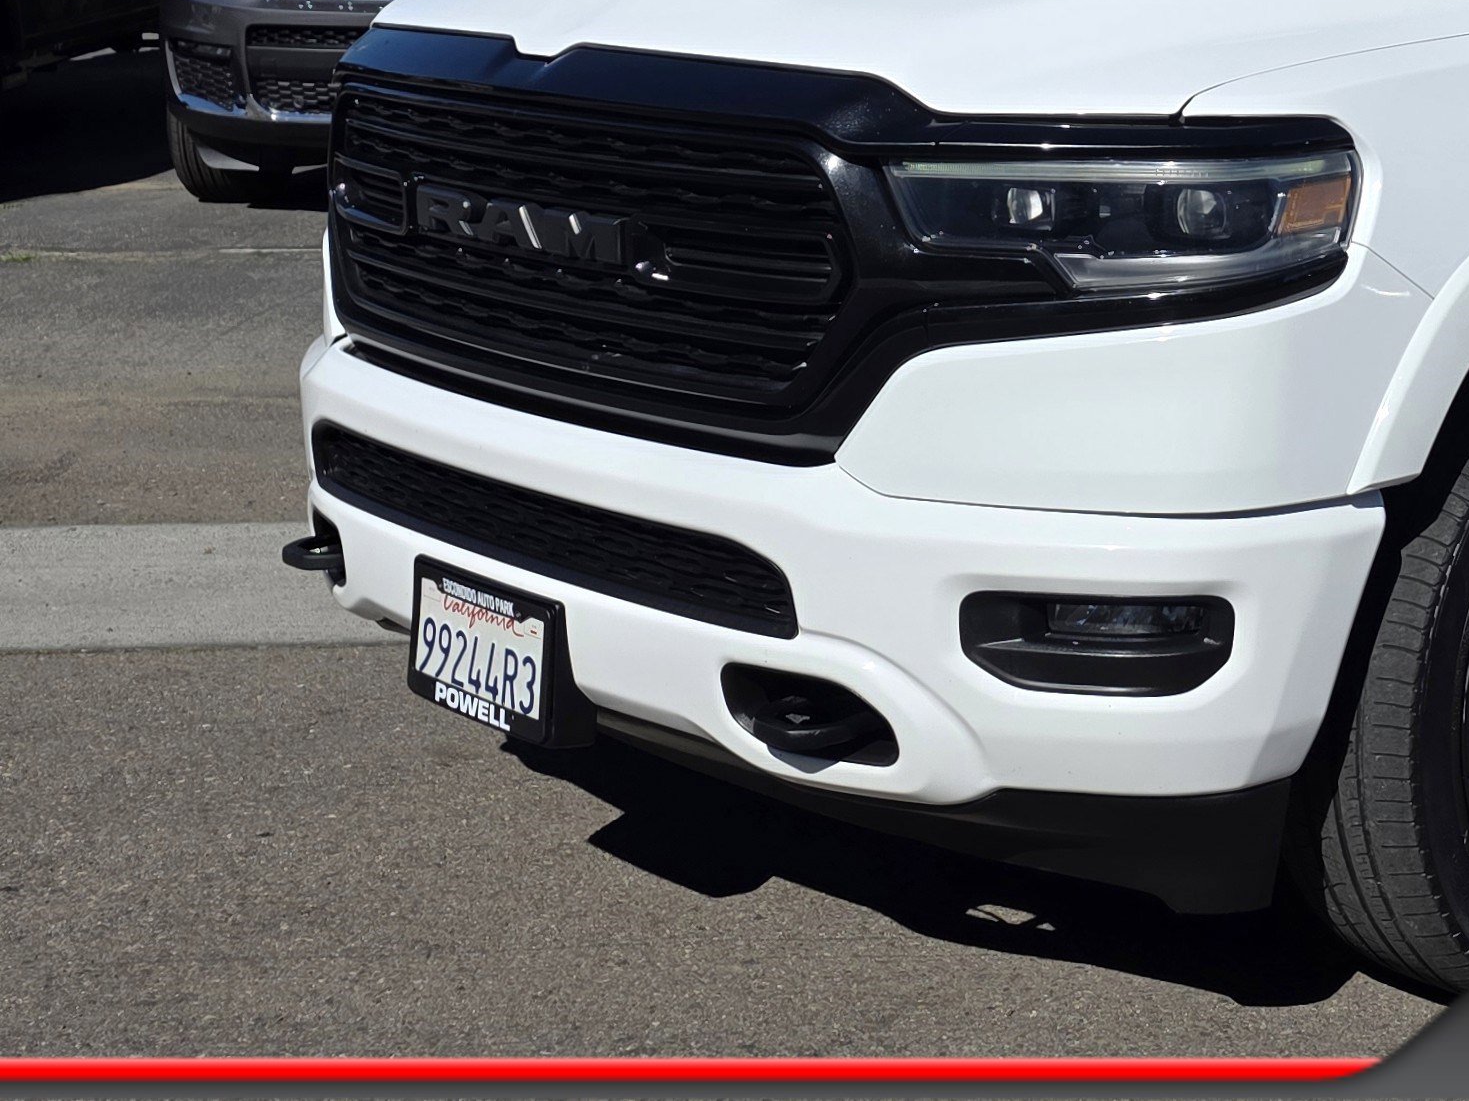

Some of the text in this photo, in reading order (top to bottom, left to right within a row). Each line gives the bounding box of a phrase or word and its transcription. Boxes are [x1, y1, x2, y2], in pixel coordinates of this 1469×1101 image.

[416, 184, 628, 265] RAM
[477, 590, 495, 610] AUTO
[495, 597, 515, 617] PARK
[418, 616, 537, 716] 99244R3
[434, 680, 511, 732] POWELL
